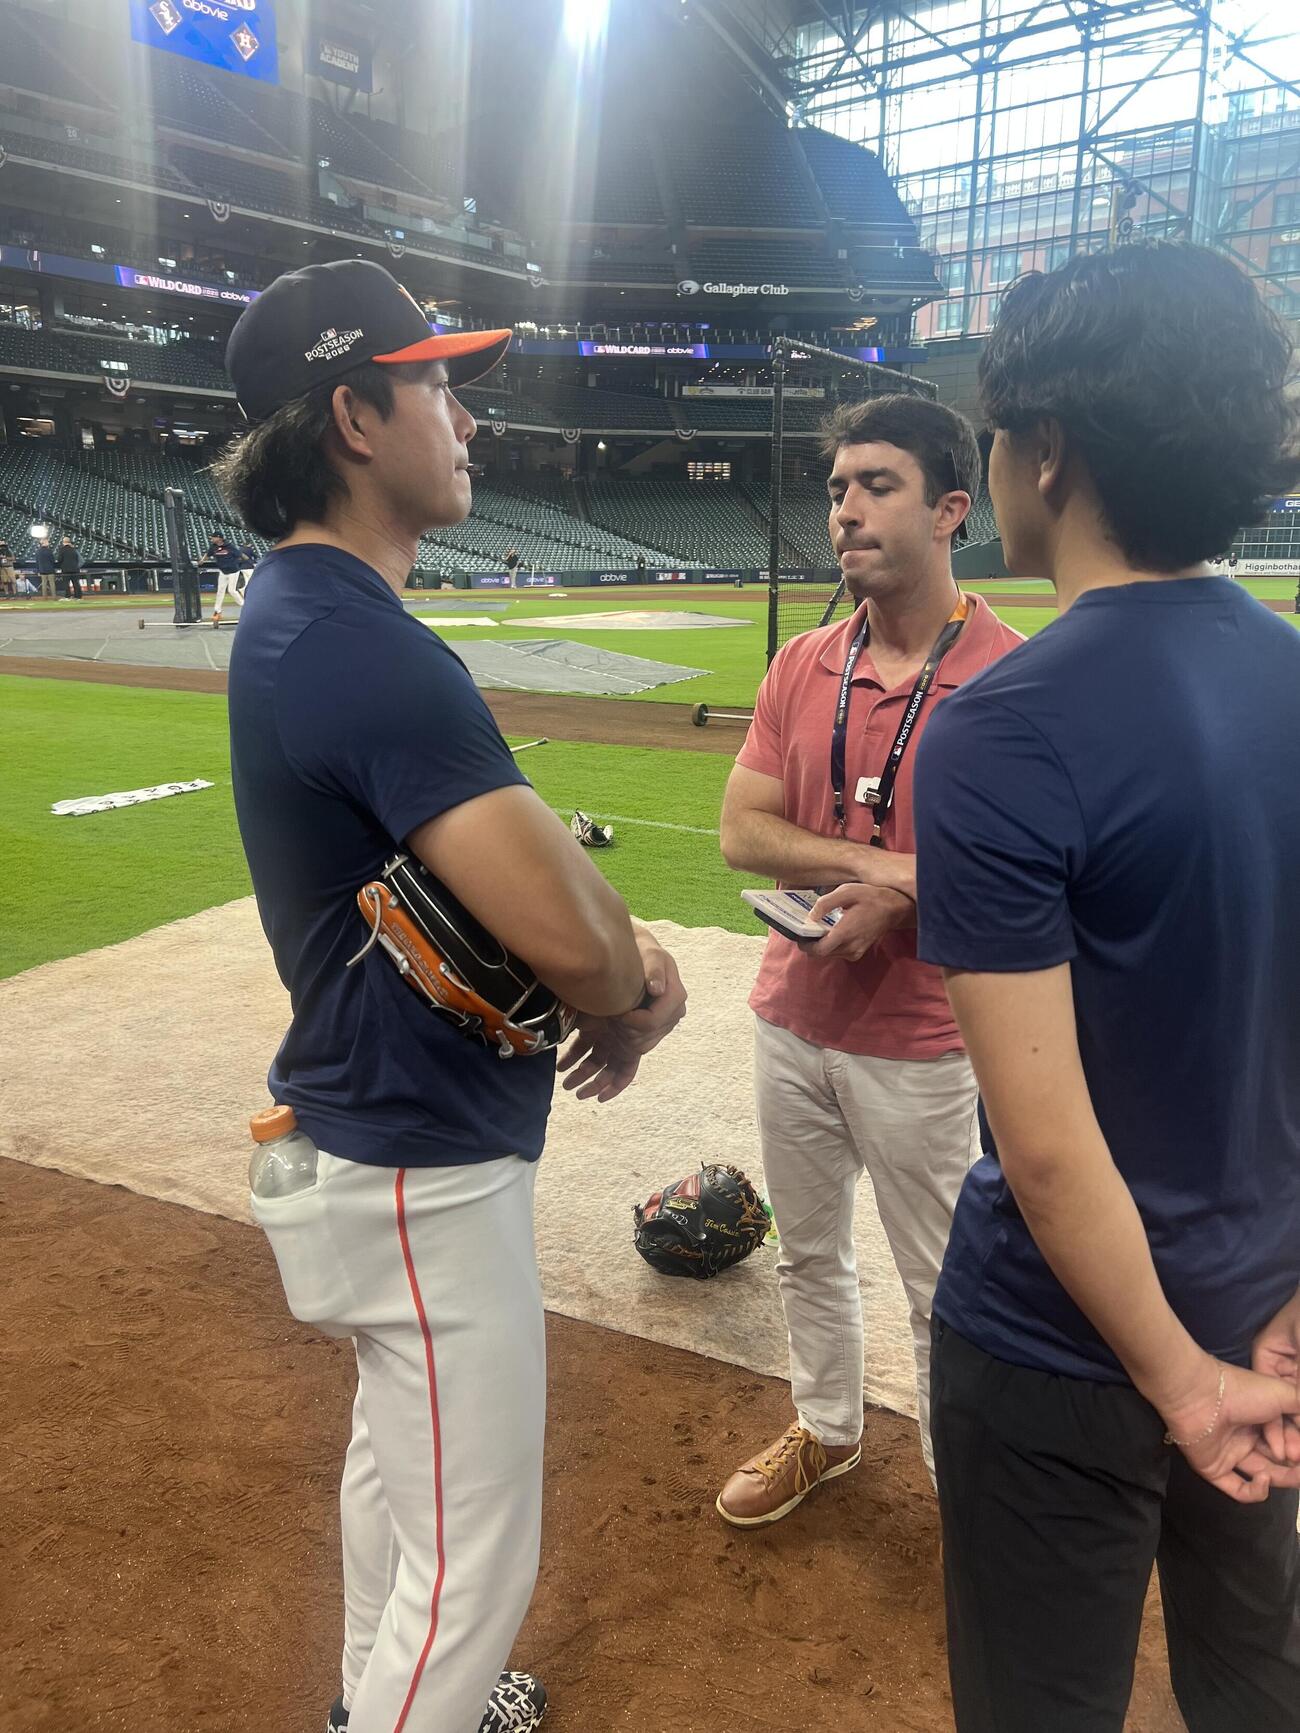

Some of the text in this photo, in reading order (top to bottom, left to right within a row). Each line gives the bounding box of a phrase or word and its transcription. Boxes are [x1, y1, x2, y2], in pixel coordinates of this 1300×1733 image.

[220, 291, 251, 303] abbvie
[703, 282, 759, 298] Gallagher
[760, 284, 789, 295] Club
[304, 328, 364, 362] POSTSEASON
[1245, 563, 1300, 572] Higginbotha
[600, 573, 627, 582] abbvie
[839, 655, 855, 708] POSTSEASON
[896, 691, 924, 746] POSTSEASON
